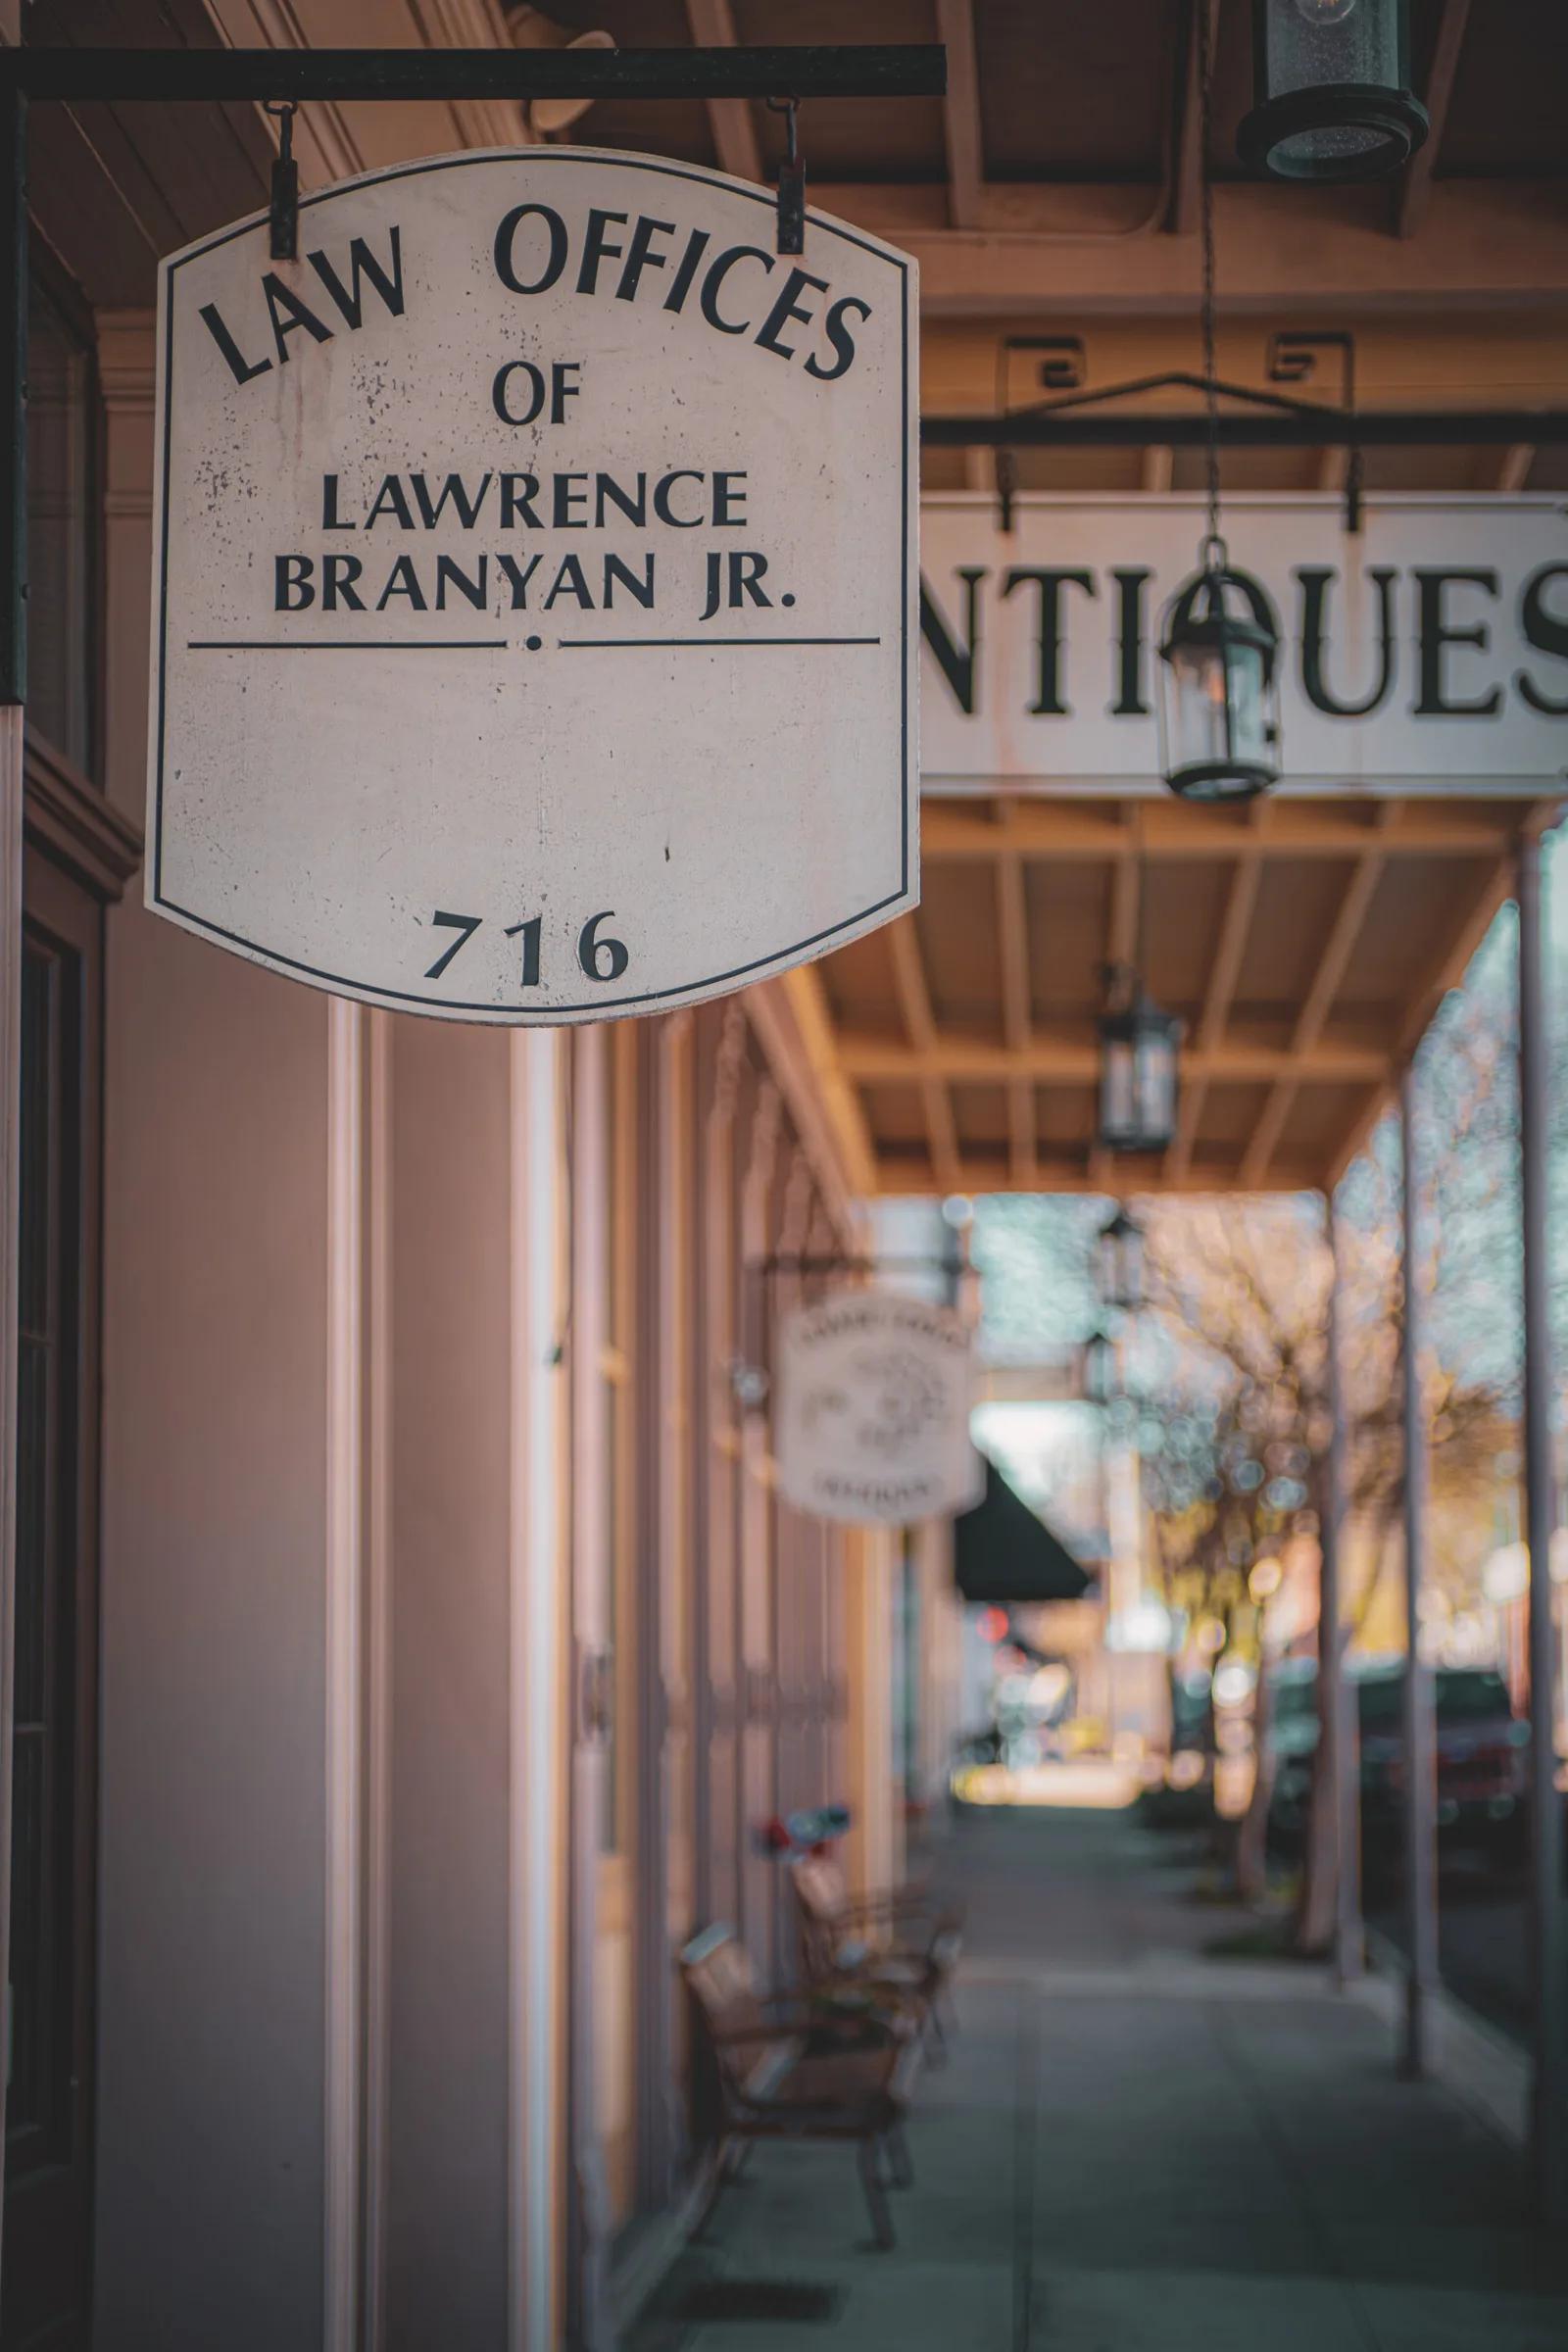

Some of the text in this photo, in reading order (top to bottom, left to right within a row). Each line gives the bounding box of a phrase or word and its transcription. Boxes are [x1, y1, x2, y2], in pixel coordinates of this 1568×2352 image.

[199, 202, 872, 386] LAW OFFICES
[492, 360, 581, 426] OF
[322, 469, 749, 530] LAWRENCE
[274, 551, 796, 621] BRANYAN JR.
[423, 909, 629, 987] 716
